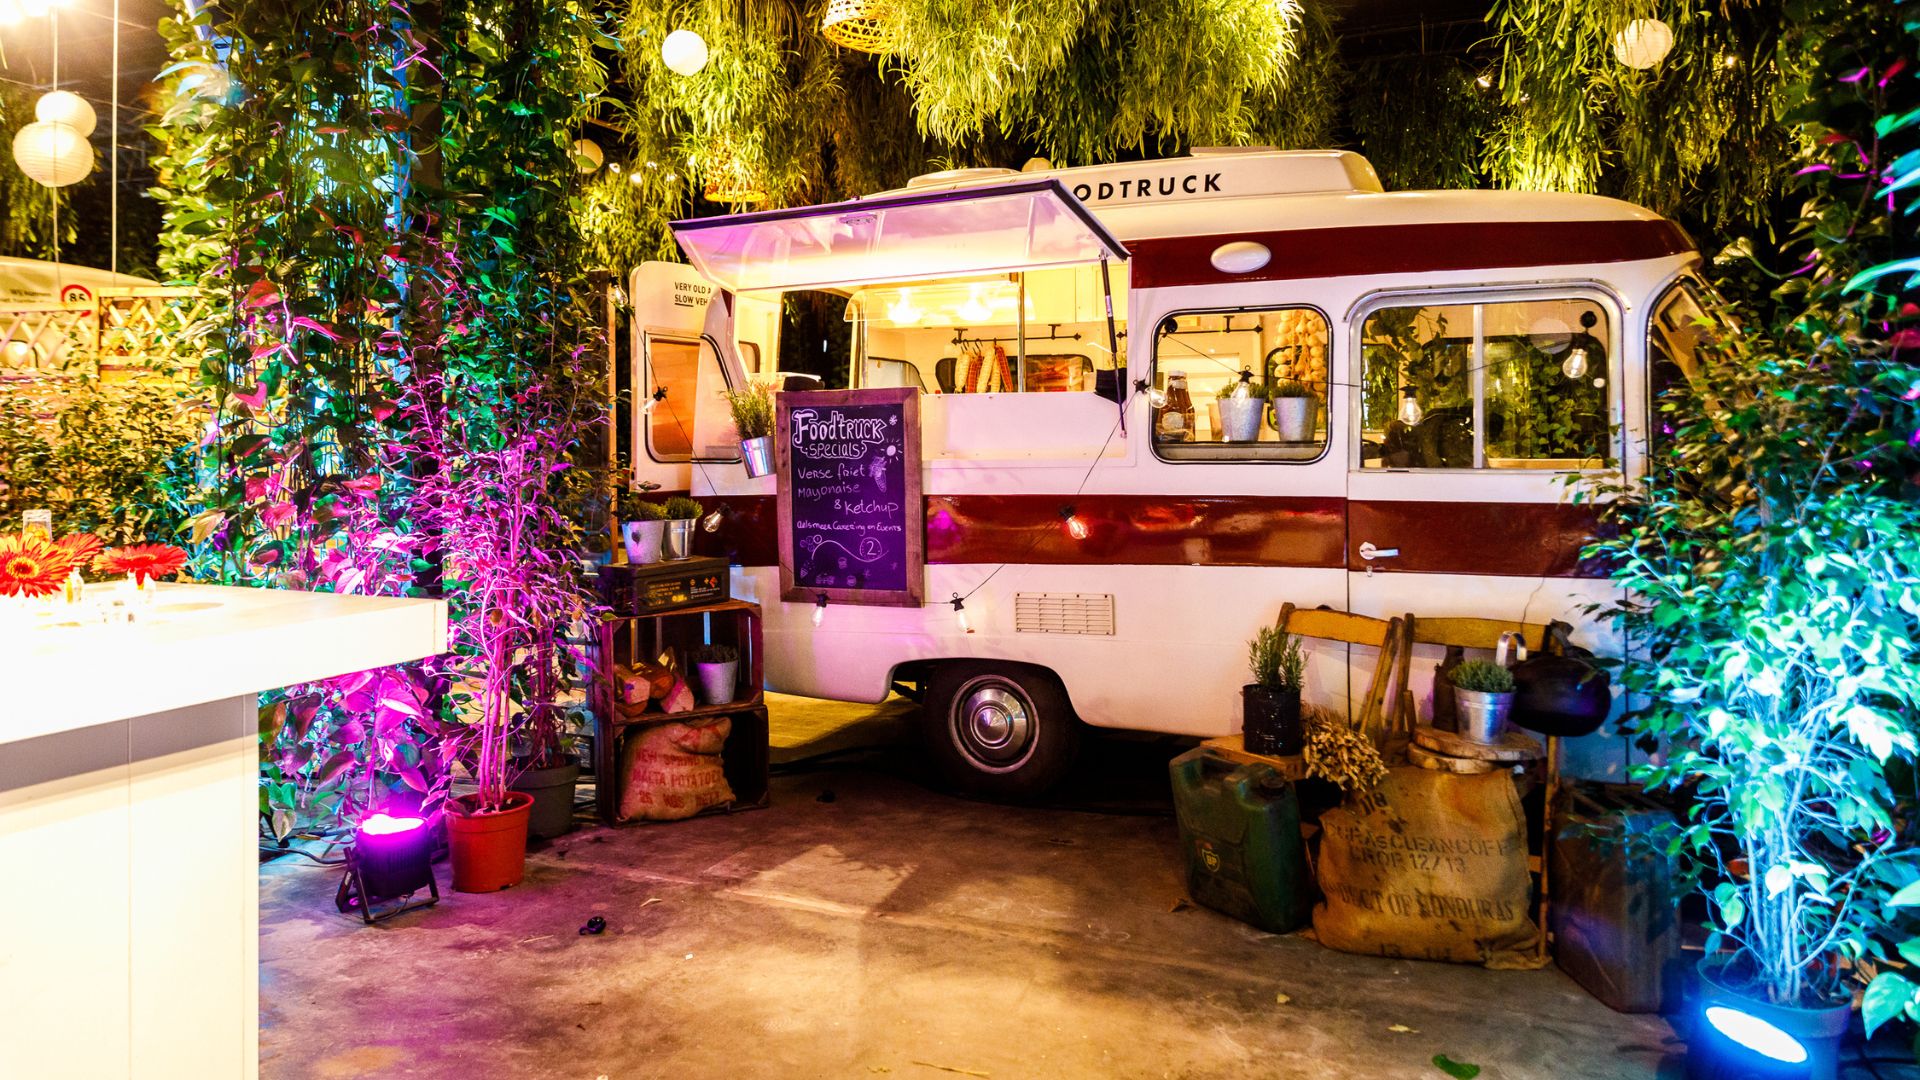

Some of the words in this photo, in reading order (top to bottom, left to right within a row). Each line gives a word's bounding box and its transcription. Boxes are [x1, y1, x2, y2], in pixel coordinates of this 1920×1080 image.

[1072, 172, 1222, 202] ODTRUCK
[674, 281, 692, 292] VERY
[692, 284, 706, 294] OLD
[674, 294, 694, 304] SLOW
[809, 441, 861, 458] specials
[797, 467, 834, 480] Verse
[837, 462, 866, 481] friet
[797, 481, 861, 502] Mayonaise
[833, 498, 842, 510] &
[866, 540, 877, 556] 2
[1455, 838, 1505, 857] COFF
[1408, 852, 1466, 873] 12/13
[1387, 892, 1412, 917] OF
